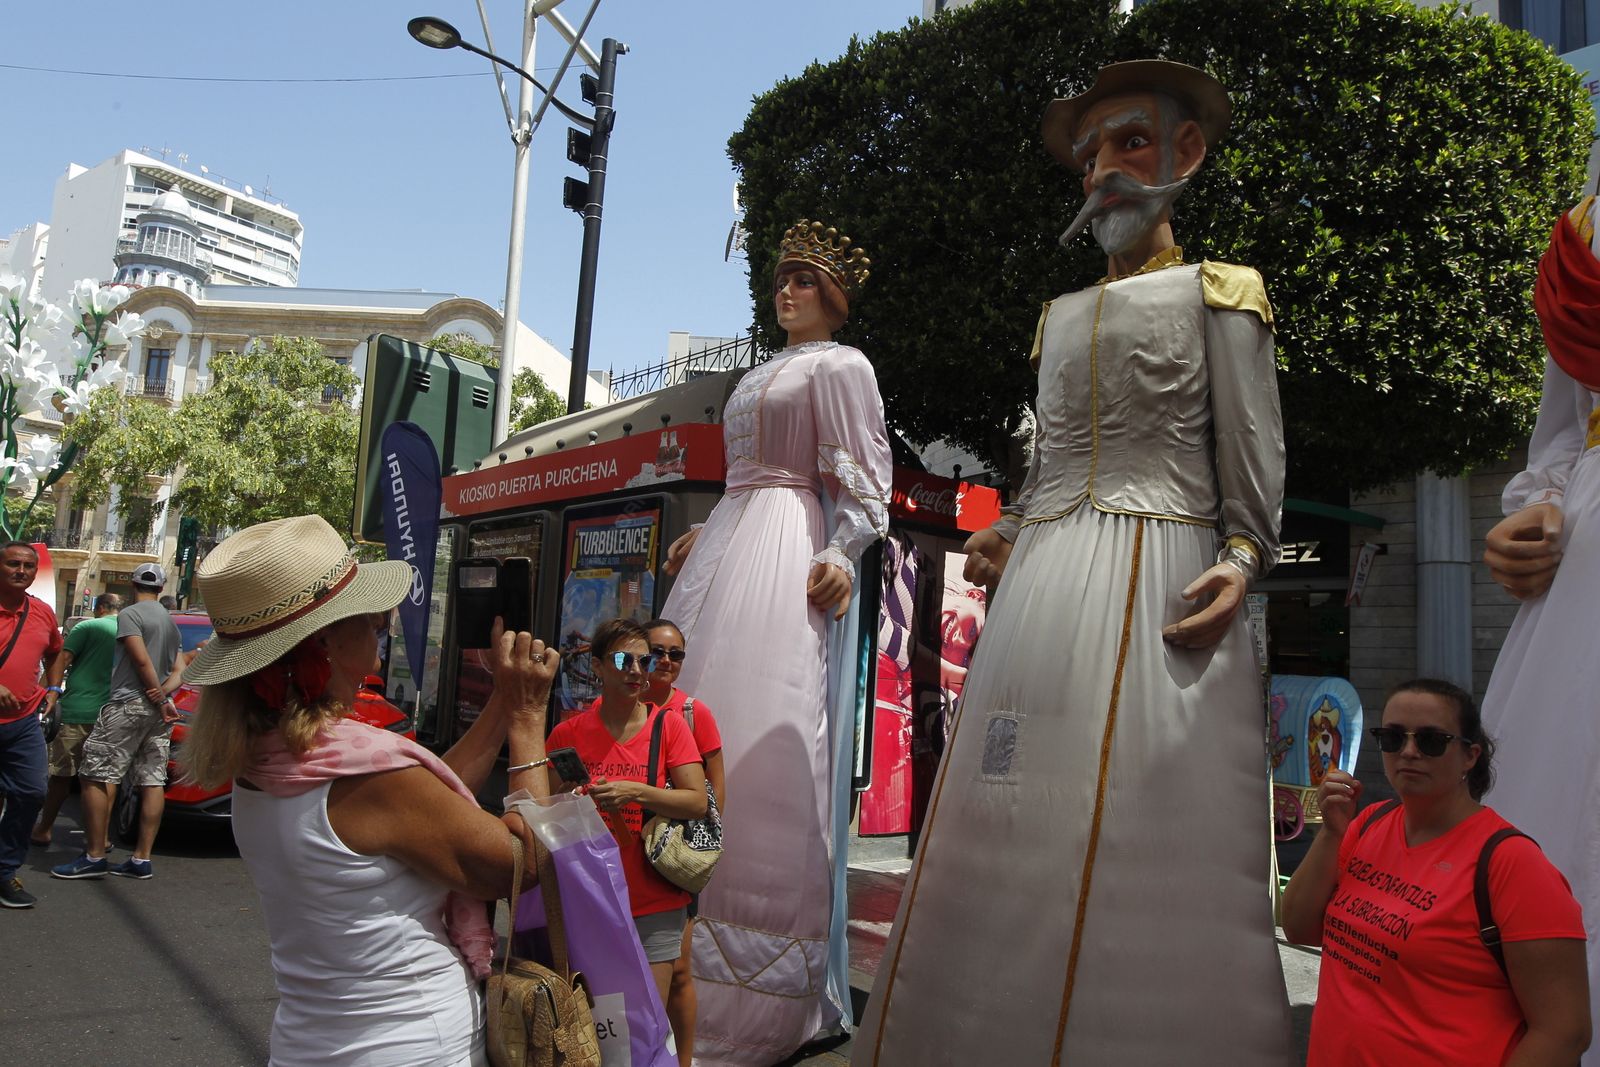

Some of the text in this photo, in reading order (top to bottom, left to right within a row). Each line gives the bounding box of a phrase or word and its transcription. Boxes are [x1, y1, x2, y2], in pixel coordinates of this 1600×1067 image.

[459, 458, 618, 505] KIOSKO PUERTA PURCHENA
[579, 527, 649, 556] TURBULENCE
